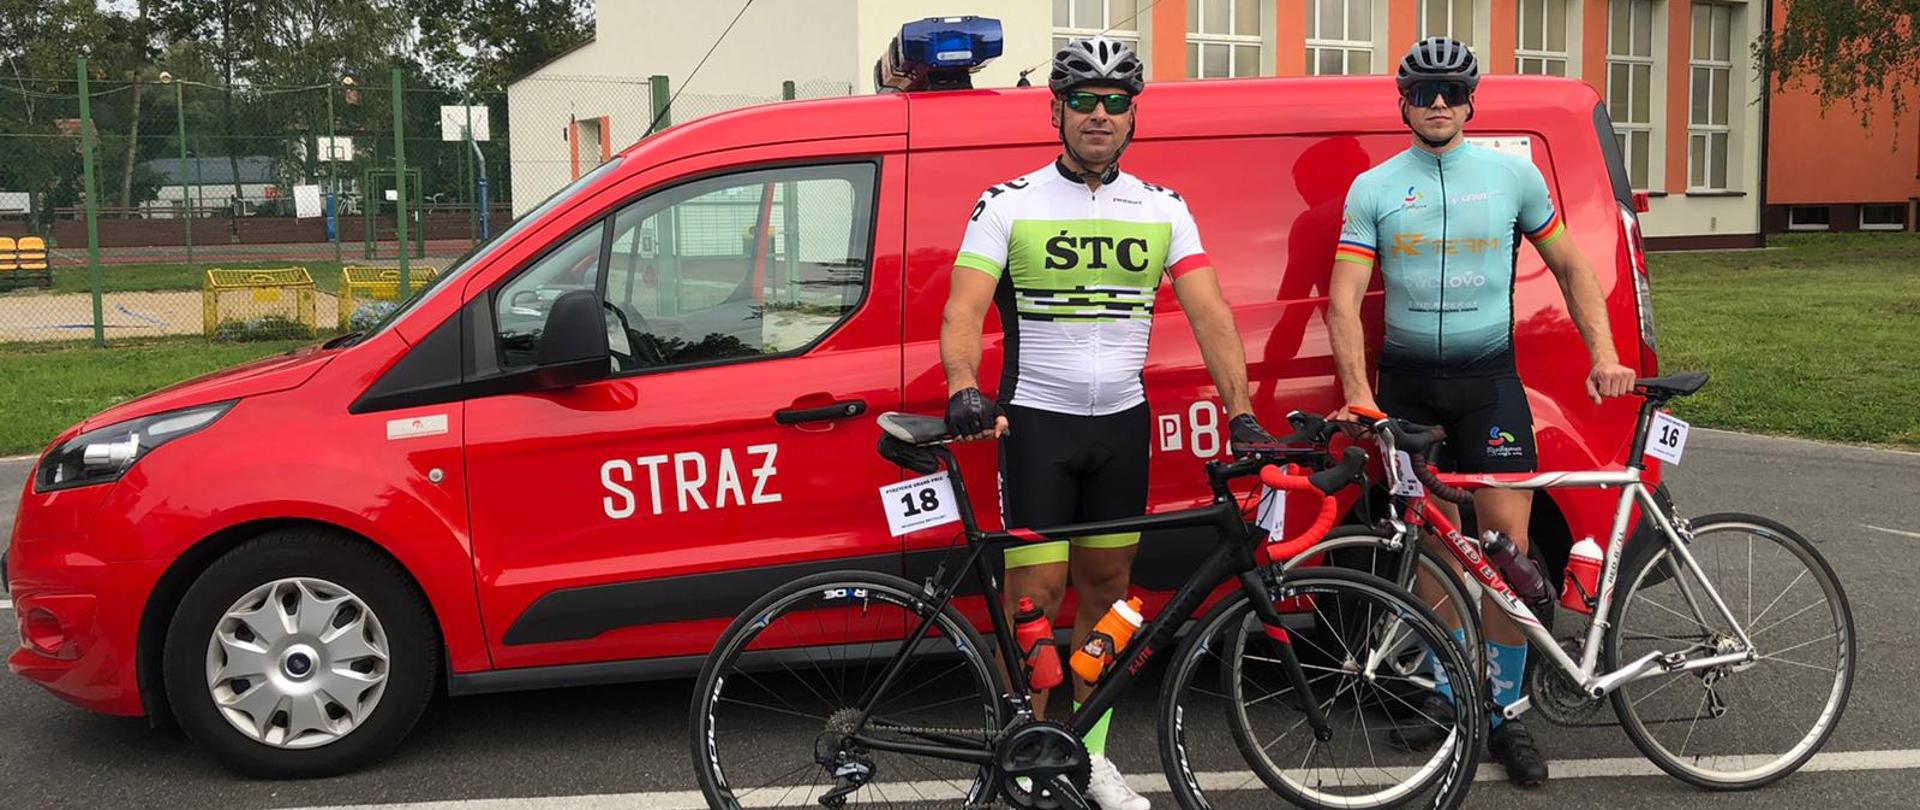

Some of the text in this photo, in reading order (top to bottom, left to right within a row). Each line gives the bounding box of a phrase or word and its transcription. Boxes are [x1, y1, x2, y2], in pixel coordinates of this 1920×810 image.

[1045, 230, 1149, 272] ŚTC
[1189, 400, 1232, 458] 8
[1659, 424, 1679, 448] 16
[901, 487, 939, 517] 18
